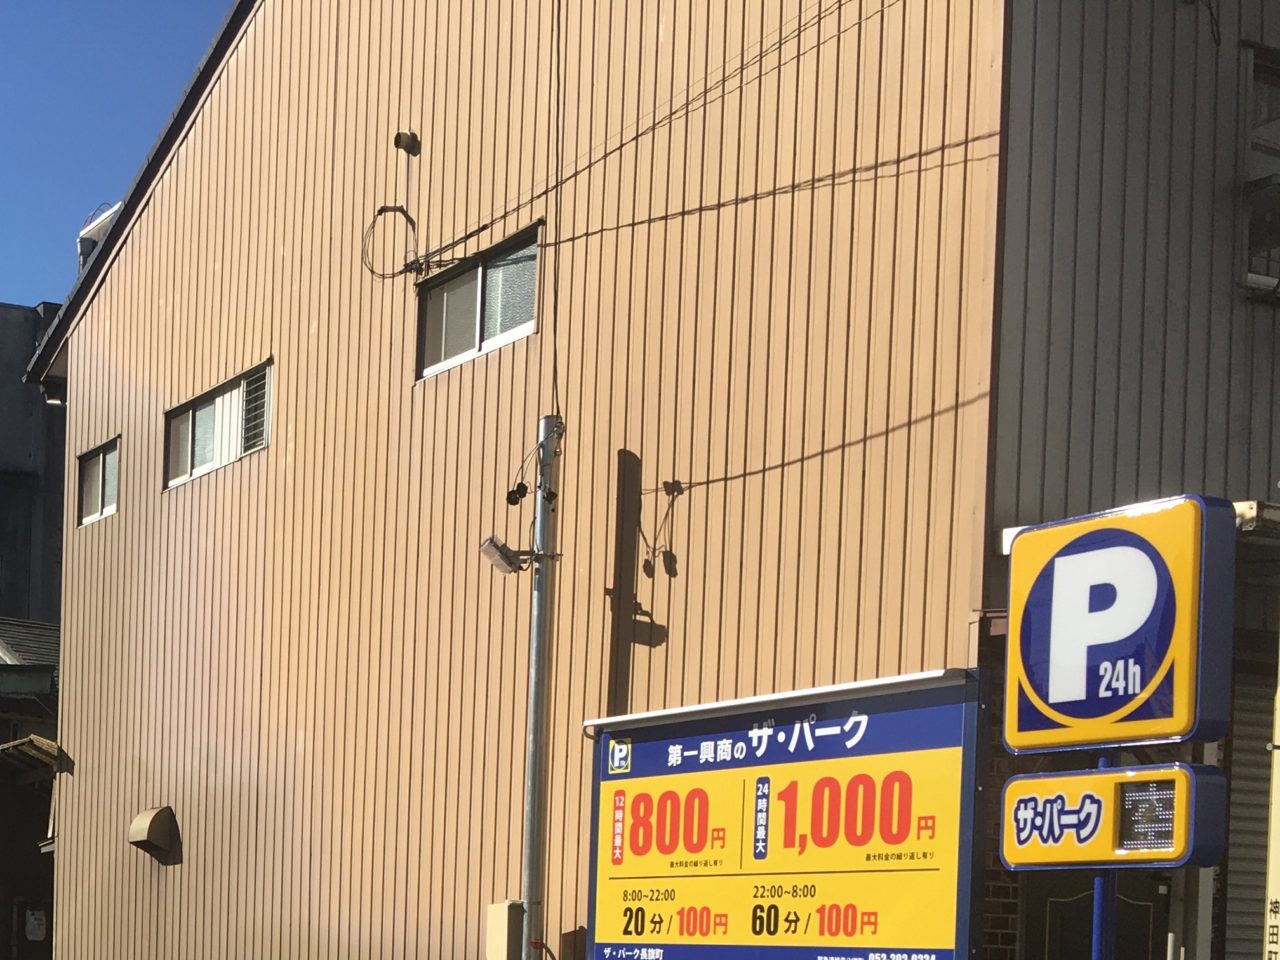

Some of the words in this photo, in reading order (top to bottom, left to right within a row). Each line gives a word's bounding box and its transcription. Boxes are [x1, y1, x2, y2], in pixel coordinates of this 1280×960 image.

[1048, 546, 1158, 704] P
[1099, 658, 1141, 698] 24h
[1015, 796, 1100, 845] ザ・パーク
